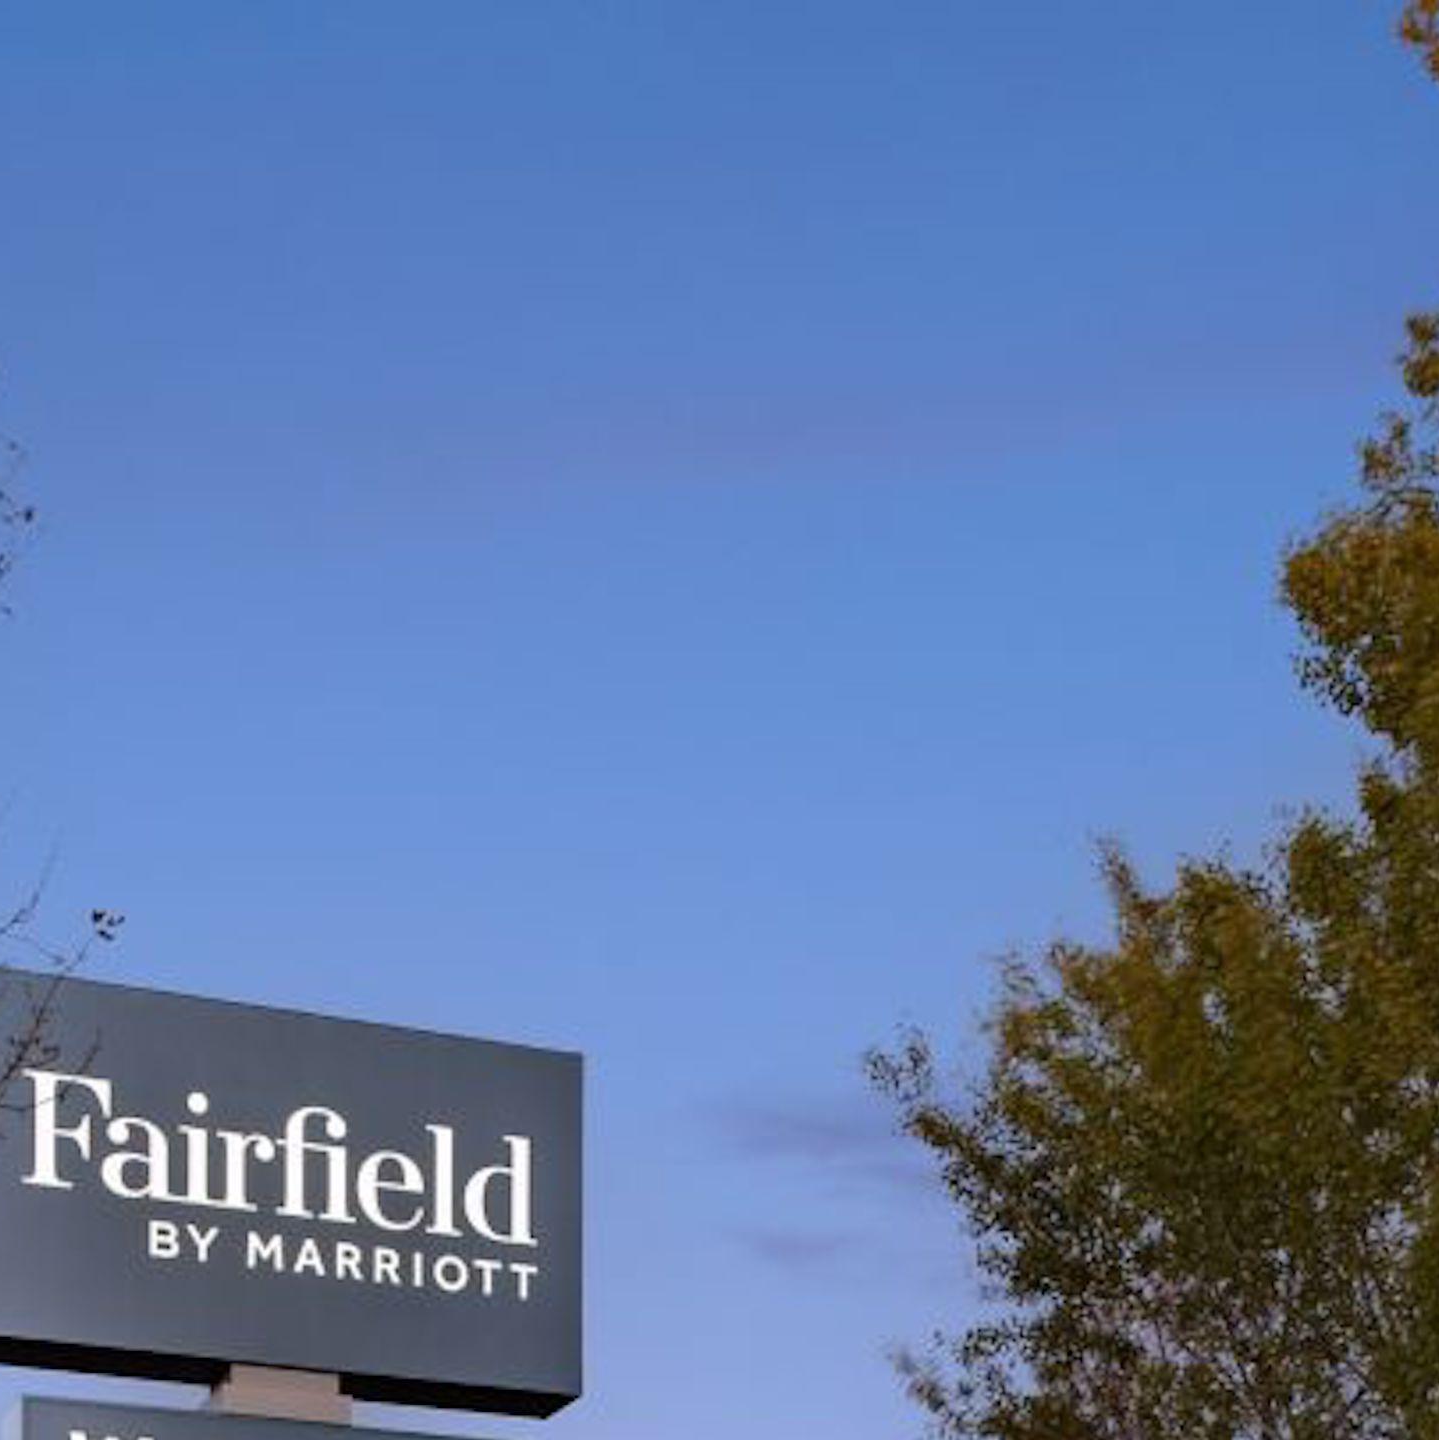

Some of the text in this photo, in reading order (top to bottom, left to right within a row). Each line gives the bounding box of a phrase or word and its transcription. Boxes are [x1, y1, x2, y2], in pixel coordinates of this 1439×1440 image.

[21, 1069, 539, 1247] Fairfield
[149, 1219, 538, 1300] BY MARRIOTT
